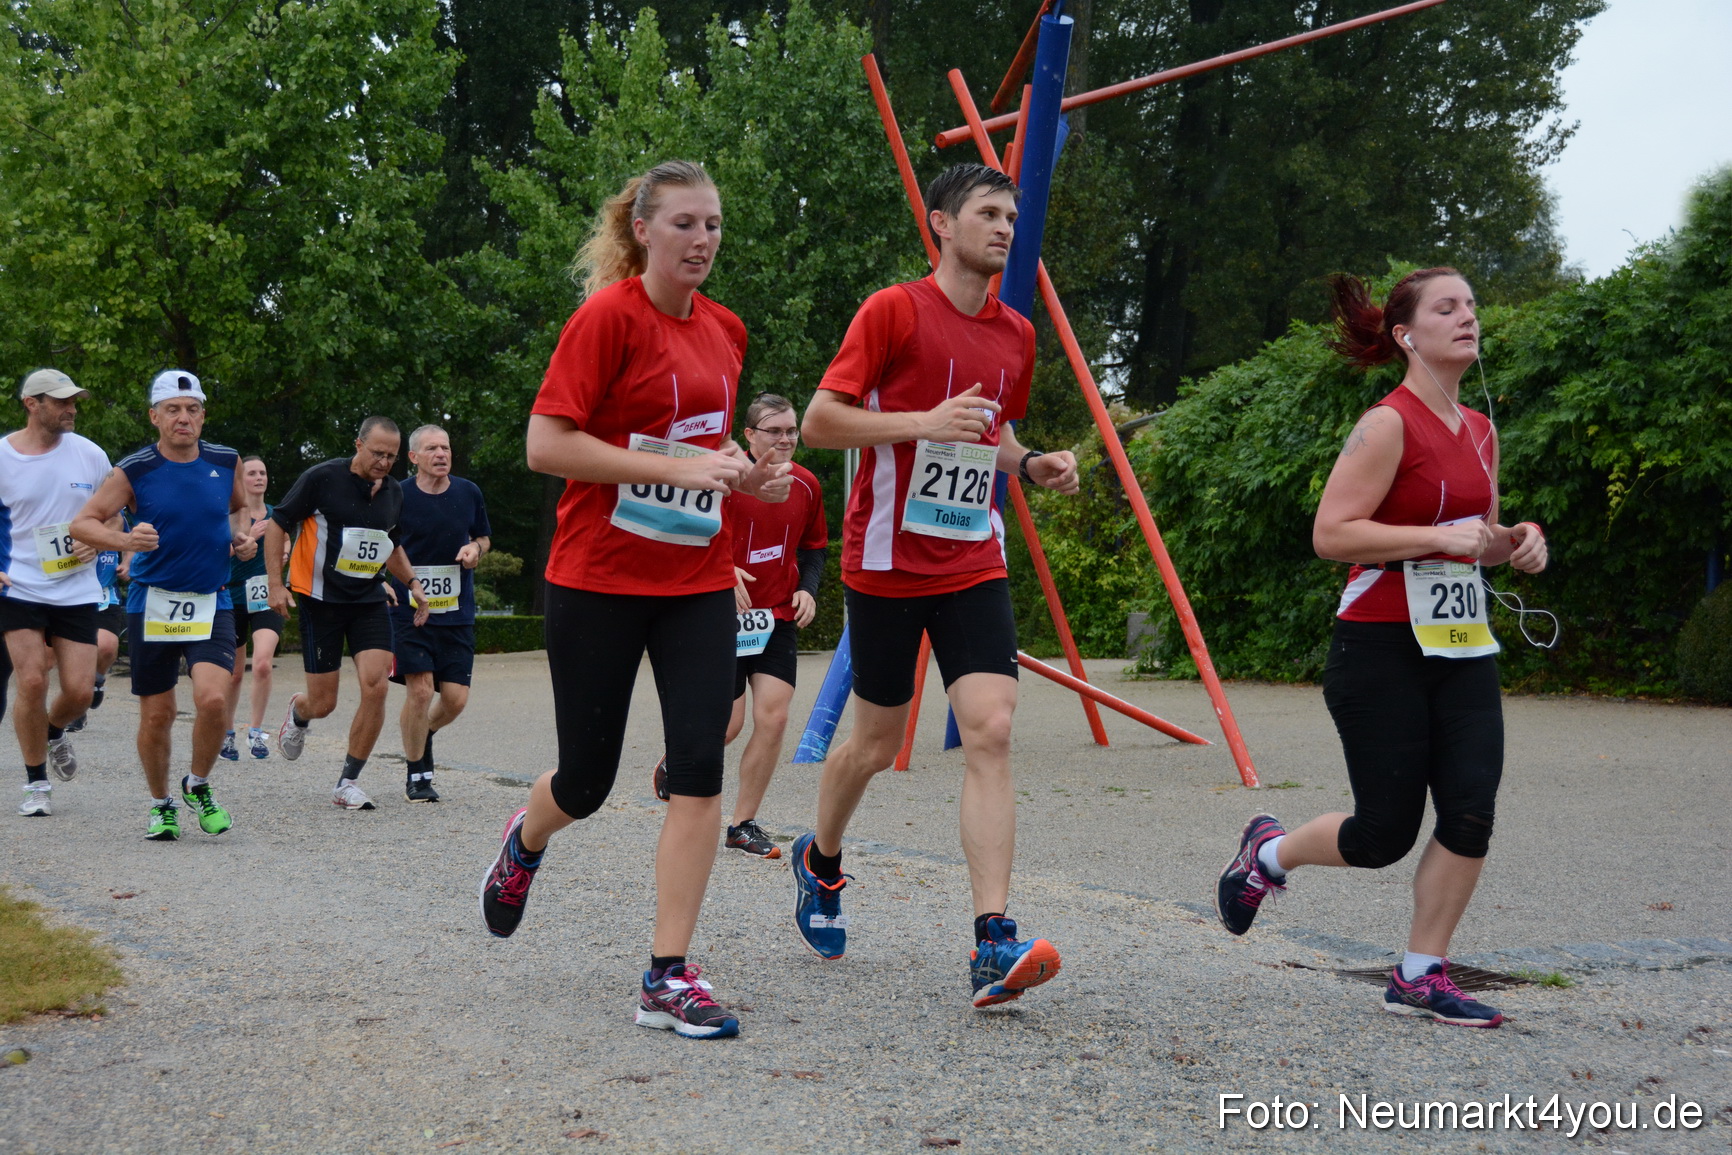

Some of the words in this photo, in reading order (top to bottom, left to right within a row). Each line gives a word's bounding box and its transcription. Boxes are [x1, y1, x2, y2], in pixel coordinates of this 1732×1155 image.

[683, 420, 708, 433] DEHN
[925, 447, 956, 459] NeuerMarkt
[961, 446, 994, 462] BOCK
[919, 462, 990, 505] 2126
[935, 509, 971, 527] Tobias
[50, 535, 74, 556] 18
[357, 541, 379, 560] 55
[349, 562, 378, 573] Matthias
[251, 585, 268, 600] 23
[420, 577, 452, 595] 258
[428, 599, 449, 607] erbert
[1430, 582, 1478, 619] 230
[168, 600, 196, 621] 79
[164, 624, 192, 633] Stefan
[1450, 629, 1468, 643] Eva
[736, 637, 760, 648] anuel
